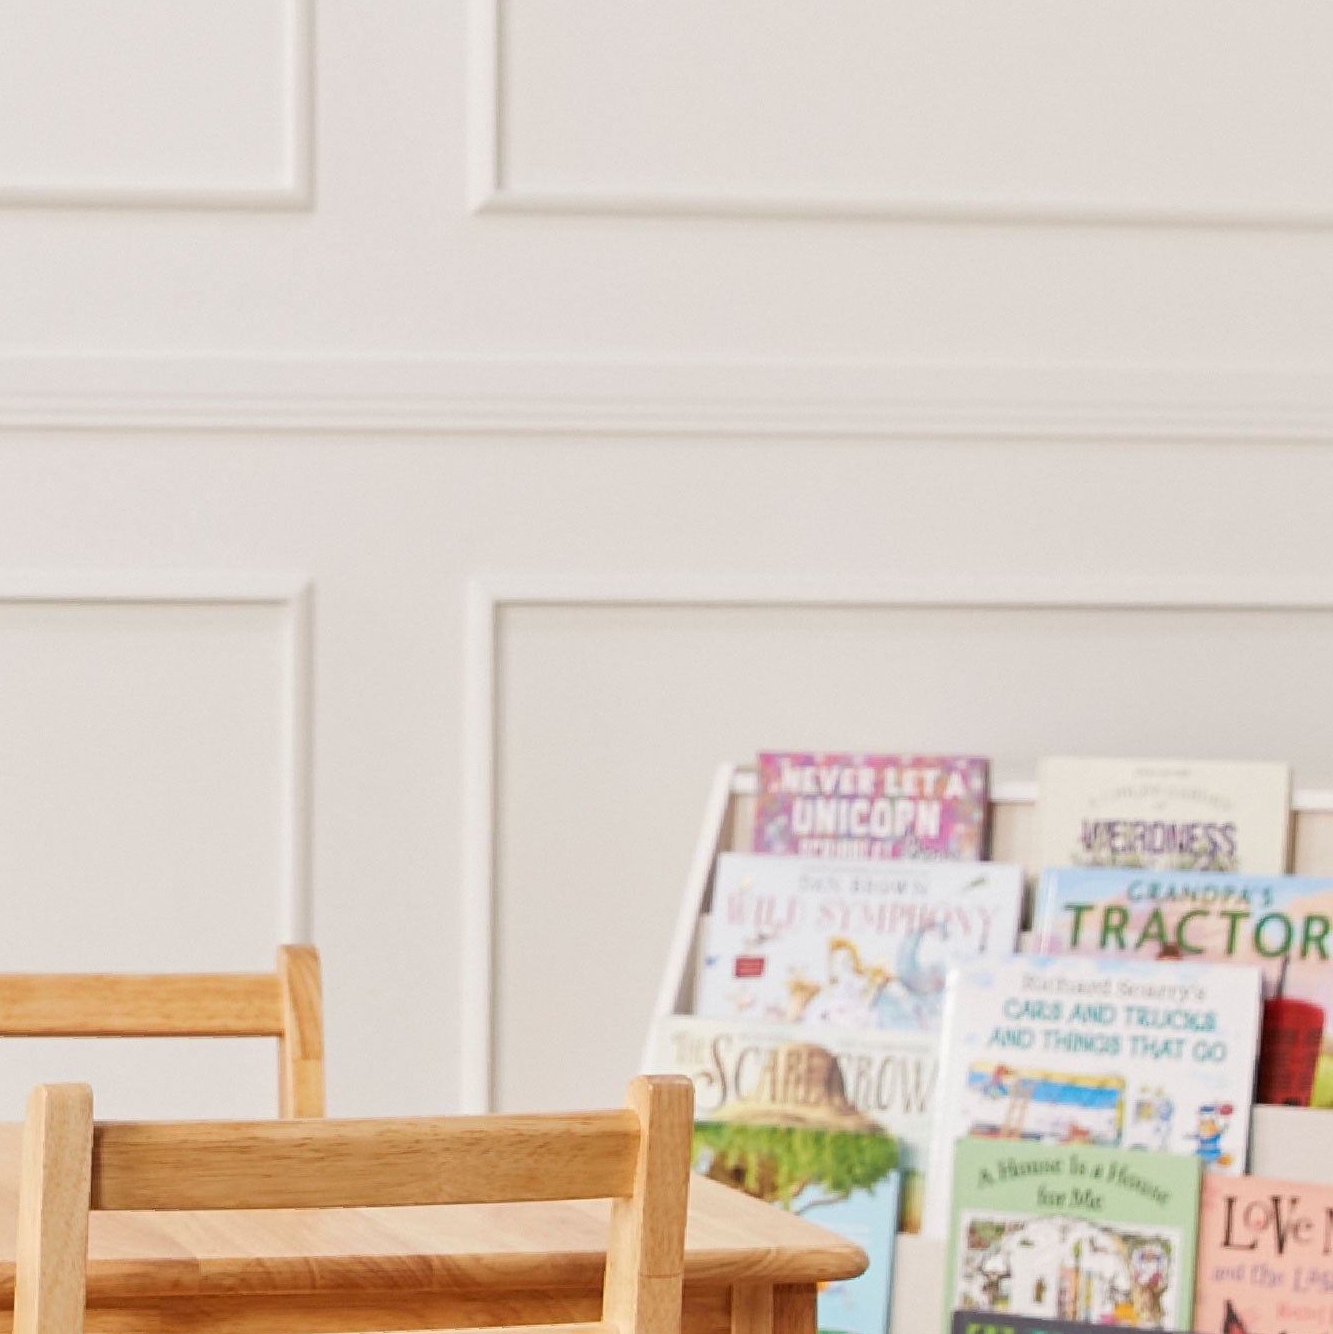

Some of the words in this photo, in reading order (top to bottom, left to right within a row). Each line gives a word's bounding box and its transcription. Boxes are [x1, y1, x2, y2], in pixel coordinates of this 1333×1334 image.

[781, 759, 876, 796] NEVER
[884, 765, 939, 796] LET
[944, 767, 966, 797] A
[791, 798, 941, 838] UNICORN
[1064, 899, 1331, 960] TRACTOR
[1003, 997, 1062, 1022] CARS
[1070, 1001, 1117, 1025] AND
[1125, 1004, 1218, 1032] TRUCKS
[988, 1026, 1035, 1051] AND
[1041, 1029, 1121, 1056] THINGS
[1129, 1034, 1186, 1060] THAT
[1192, 1037, 1229, 1062] GO
[978, 1167, 994, 1189] A
[998, 1157, 1061, 1182] House
[1107, 1160, 1171, 1208] House
[1037, 1183, 1066, 1207] for
[1069, 1187, 1103, 1210] Me
